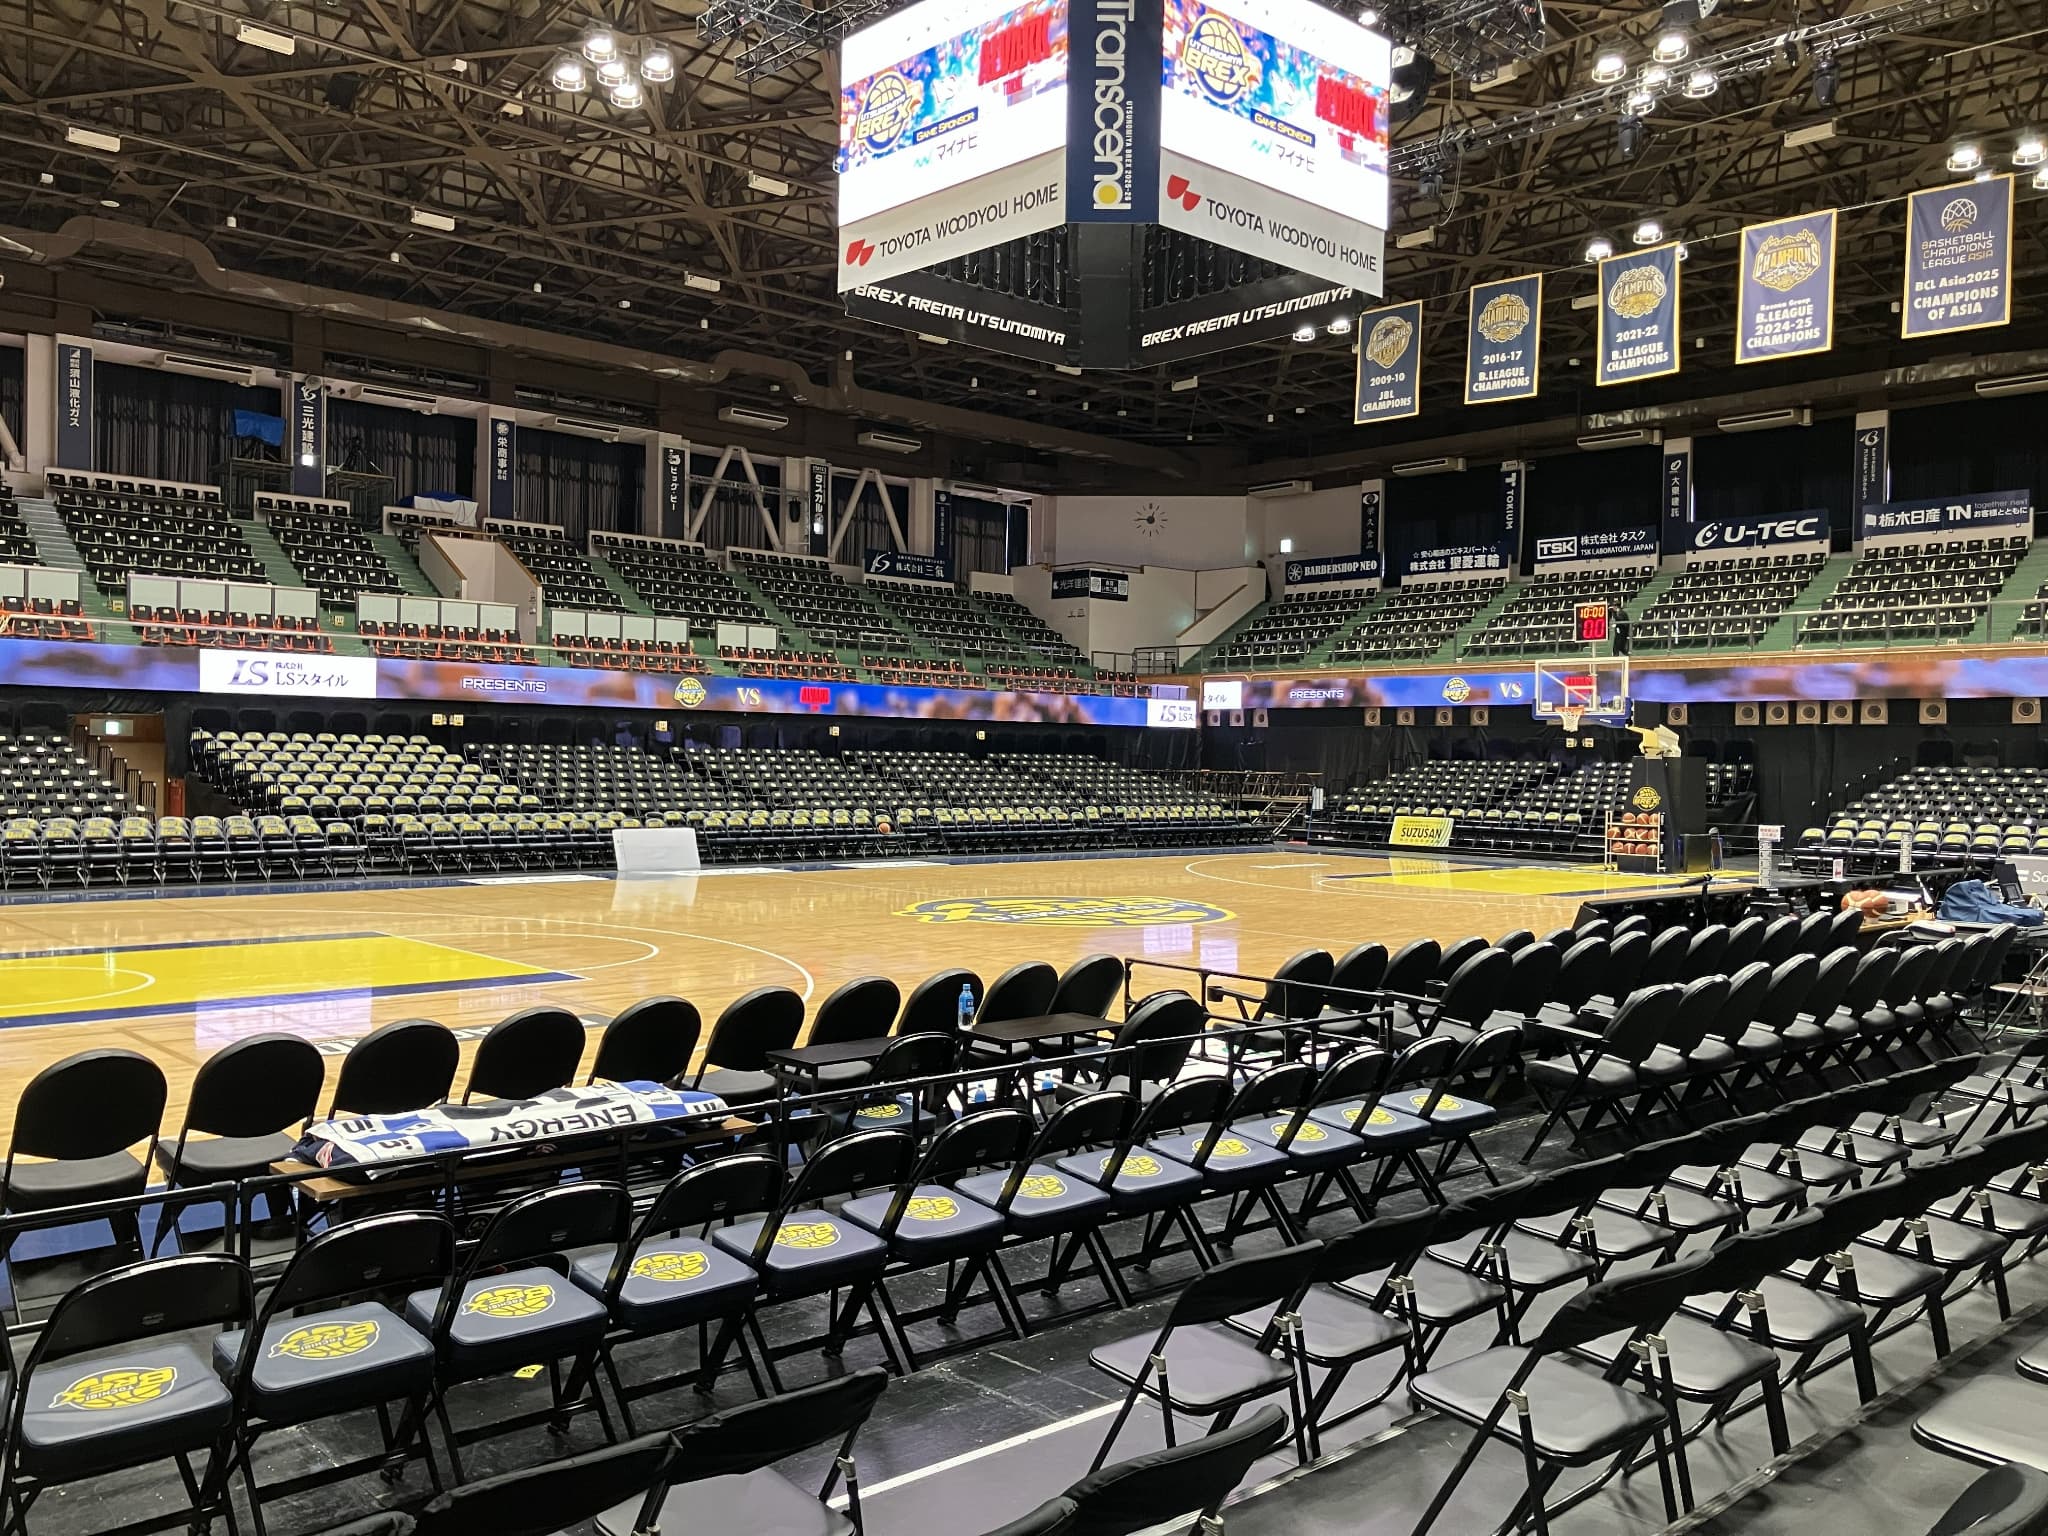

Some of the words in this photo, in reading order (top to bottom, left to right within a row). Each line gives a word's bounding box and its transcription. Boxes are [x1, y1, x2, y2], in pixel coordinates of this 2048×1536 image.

[1185, 49, 1250, 87] BREX
[1093, 0, 1135, 210] Transcend
[857, 96, 913, 140] BREX
[1125, 100, 1133, 147] UTSUNOMIYA
[880, 227, 931, 258] TOYOTA
[936, 200, 1008, 239] WOODYOU
[1013, 183, 1059, 215] HOME
[1206, 198, 1265, 234] TOYOTA
[1268, 220, 1337, 258] WOODYOU
[1339, 245, 1377, 272] HOME
[1922, 230, 1995, 249] BASKETBALL
[1923, 240, 1993, 259] CHAMPIONS
[1922, 255, 1966, 270] LEAGUE
[1968, 249, 1993, 261] ASIA
[1915, 279, 1936, 292] BCL
[1939, 269, 1999, 289] Asia2025
[1913, 286, 1999, 309] CHAMPIONS
[854, 284, 906, 306] BREX
[907, 295, 964, 321] ARENA
[966, 310, 1066, 346] UTSUNOMIYA
[1142, 324, 1186, 348] BREX
[1185, 311, 1241, 337] ARENA
[1242, 286, 1353, 325] UTSUNOMIYA
[1755, 305, 1813, 323] B.LEAGUE
[1928, 309, 1945, 321] OF
[1950, 302, 1982, 317] ASIA
[1615, 325, 1659, 342] 2021-22
[1755, 317, 1812, 335] 2024-25
[1746, 328, 1821, 349] CHAMPIONS
[1482, 350, 1523, 365] 2016-17
[1611, 341, 1664, 361] B.LEAGUE
[1606, 352, 1669, 373] CHAMPIONS
[1370, 372, 1406, 387] 2009-10
[1478, 366, 1525, 381] B.LEAGUE
[1472, 377, 1530, 392] CHAMPIONS
[1362, 397, 1412, 413] CHAMPIONS
[1505, 489, 1514, 530] TOKIUM
[1879, 508, 1941, 528] 栃木日産
[1946, 504, 1972, 521] TN
[1581, 533, 1618, 546] 株式会社
[1620, 530, 1646, 542] タスク
[1724, 517, 1818, 543] U-TEC
[1540, 541, 1575, 554] TSK
[1633, 543, 1654, 551] JAPAN
[1304, 562, 1359, 576] BARBERSHOP
[1360, 560, 1378, 571] NEO
[1410, 559, 1446, 572] 株式会社
[1580, 606, 1605, 618] 10:00
[228, 660, 269, 686] LS
[276, 671, 349, 687] LSスタイル
[462, 677, 546, 692] PRESENTS
[1289, 688, 1345, 699] PRESENTS
[1499, 682, 1523, 698] VS
[736, 687, 761, 706] VS
[1160, 704, 1177, 722] LS
[1401, 827, 1443, 839] SUZUSAN
[491, 1104, 637, 1143] ENERGY
[469, 1285, 552, 1312] BREX
[278, 1321, 376, 1353] BREX
[61, 1367, 174, 1404] BREX
[85, 1385, 136, 1401] TOCHIGI
